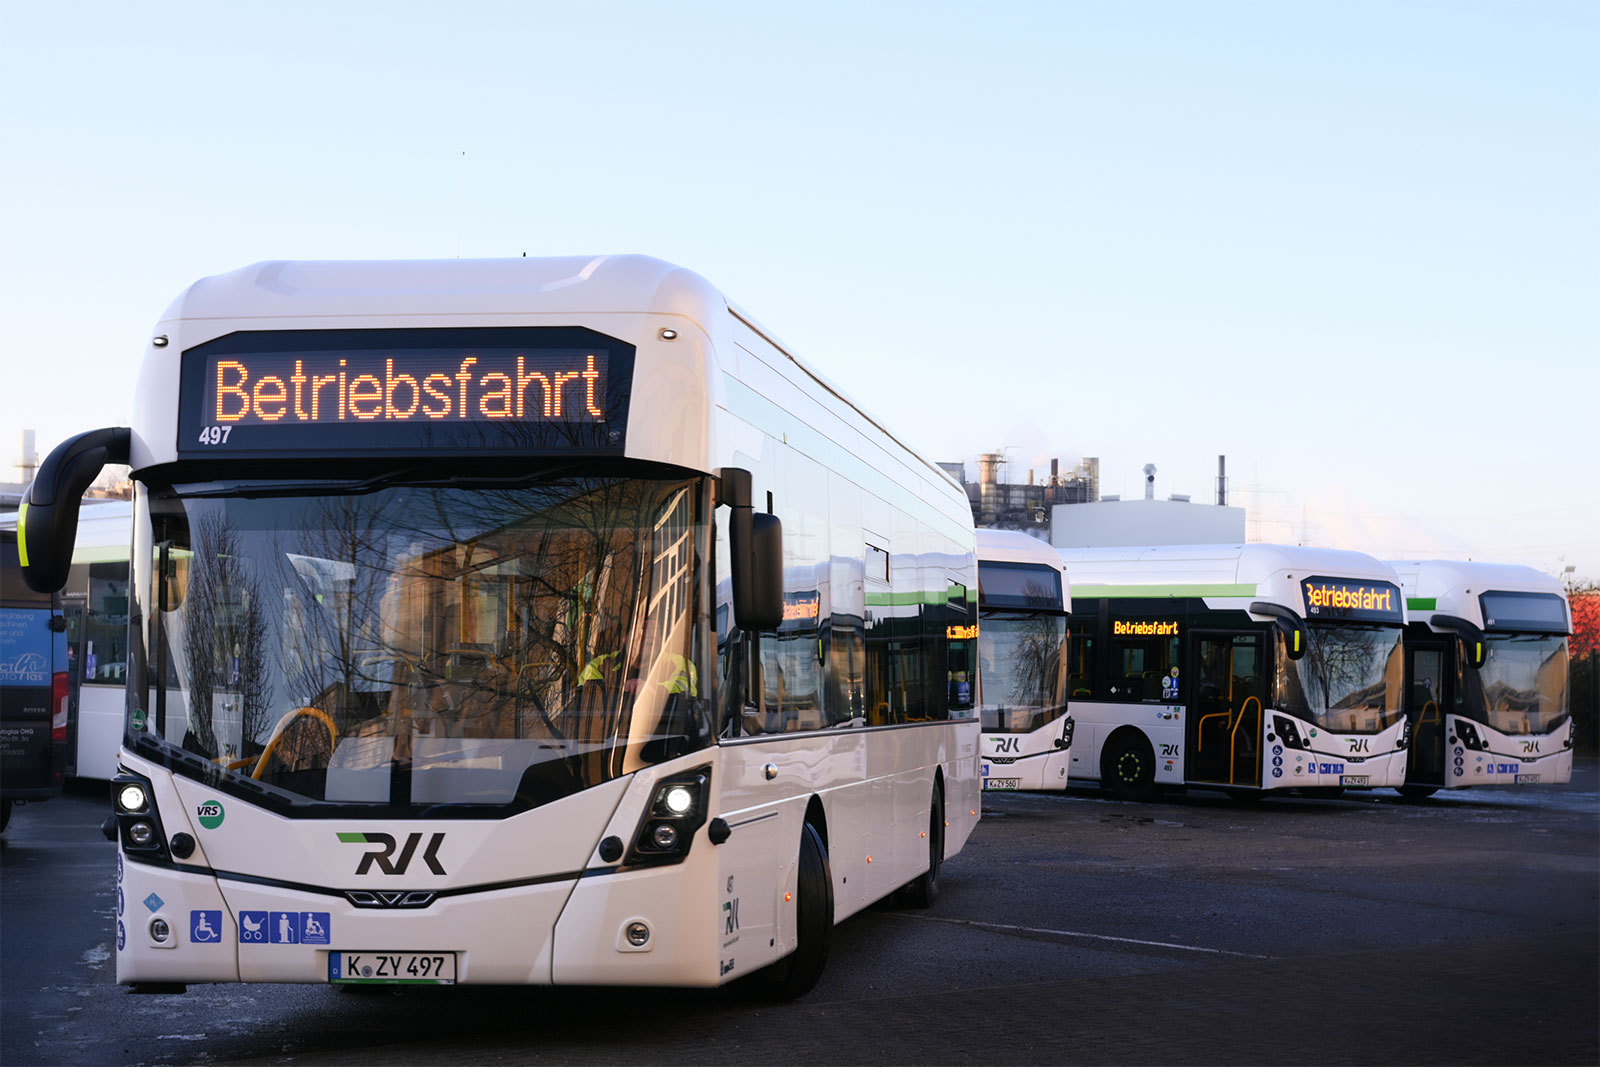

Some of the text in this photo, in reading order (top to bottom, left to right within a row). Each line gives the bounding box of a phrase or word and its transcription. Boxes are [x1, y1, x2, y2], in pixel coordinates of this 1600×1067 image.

[216, 355, 601, 421] Betriebsfahrt
[199, 425, 232, 445] 497
[1114, 621, 1178, 635] Betriebsfahrt
[197, 806, 218, 816] VRS
[336, 832, 447, 875] RVK
[348, 956, 445, 977] K ZY 497
